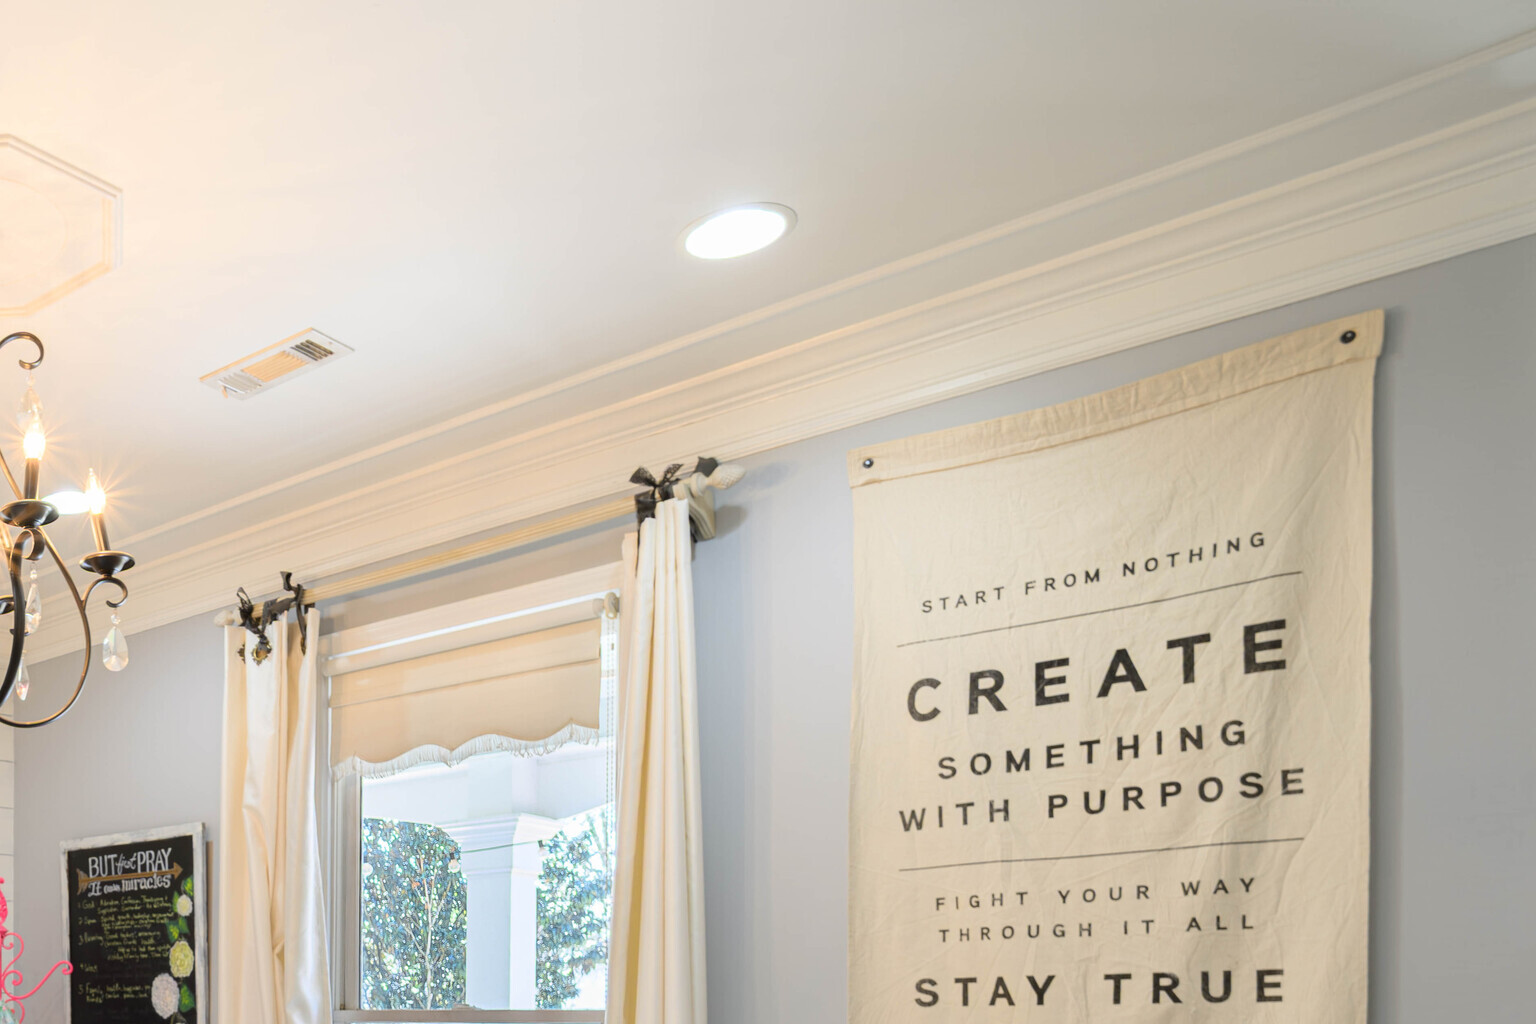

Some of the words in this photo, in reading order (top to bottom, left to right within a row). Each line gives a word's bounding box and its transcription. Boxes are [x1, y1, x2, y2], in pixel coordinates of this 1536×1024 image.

[922, 584, 1007, 613] START
[1025, 568, 1101, 595] FROM
[1123, 532, 1267, 577] NOTHING
[907, 619, 1288, 722] CREATE
[937, 719, 1249, 780] SOMETHING
[899, 800, 1012, 832] WITH
[1047, 766, 1306, 819] PURPOSE
[88, 854, 117, 878] BUT
[137, 847, 172, 873] PRAY
[122, 873, 172, 893] miracles
[935, 891, 1029, 911] FIGHT
[1058, 884, 1151, 903] YOUR
[1180, 877, 1257, 896] WAY
[939, 923, 1094, 942] THROUGH
[1123, 919, 1155, 935] IT
[1186, 914, 1255, 931] ALL
[914, 974, 1057, 1007] STAY
[1104, 969, 1285, 1004] TRUE
